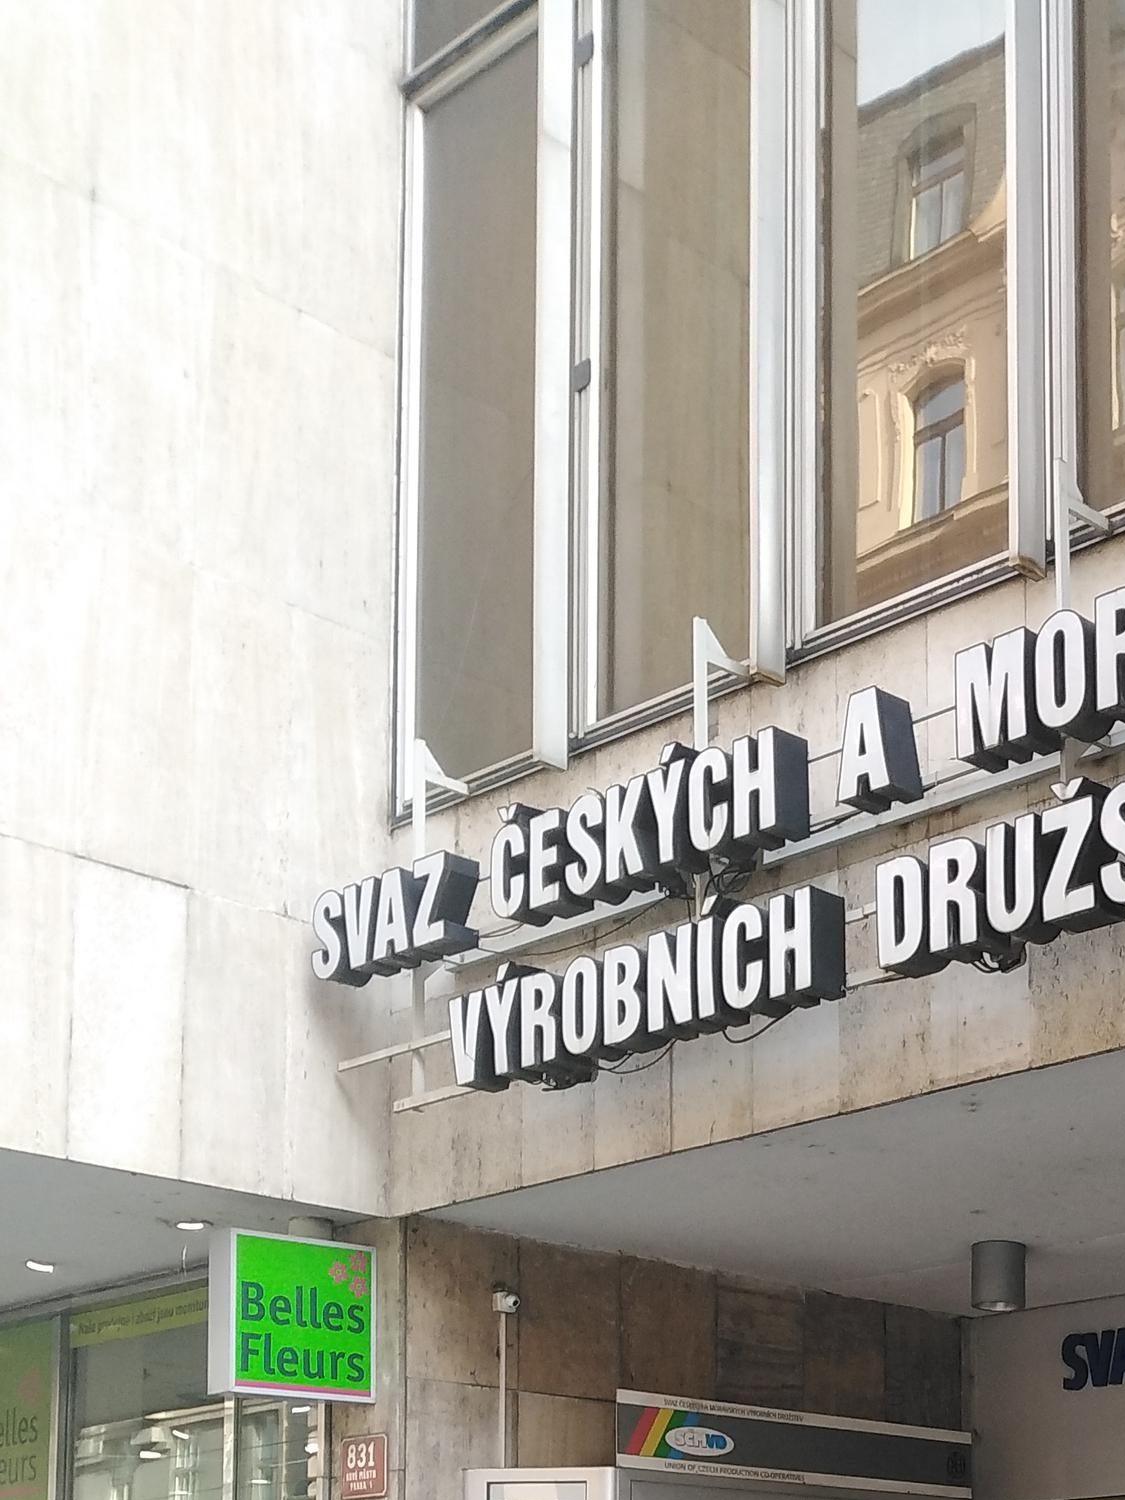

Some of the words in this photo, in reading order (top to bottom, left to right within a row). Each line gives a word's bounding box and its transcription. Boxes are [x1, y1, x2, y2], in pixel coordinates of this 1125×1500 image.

[311, 849, 460, 982] SVAZ
[491, 725, 786, 919] ČESKÝCH
[838, 685, 895, 806] A
[449, 885, 818, 1087] VÝROBNÍCH
[240, 1280, 365, 1334] Belles
[240, 1331, 365, 1382] Fleurs
[347, 1441, 375, 1469] 831
